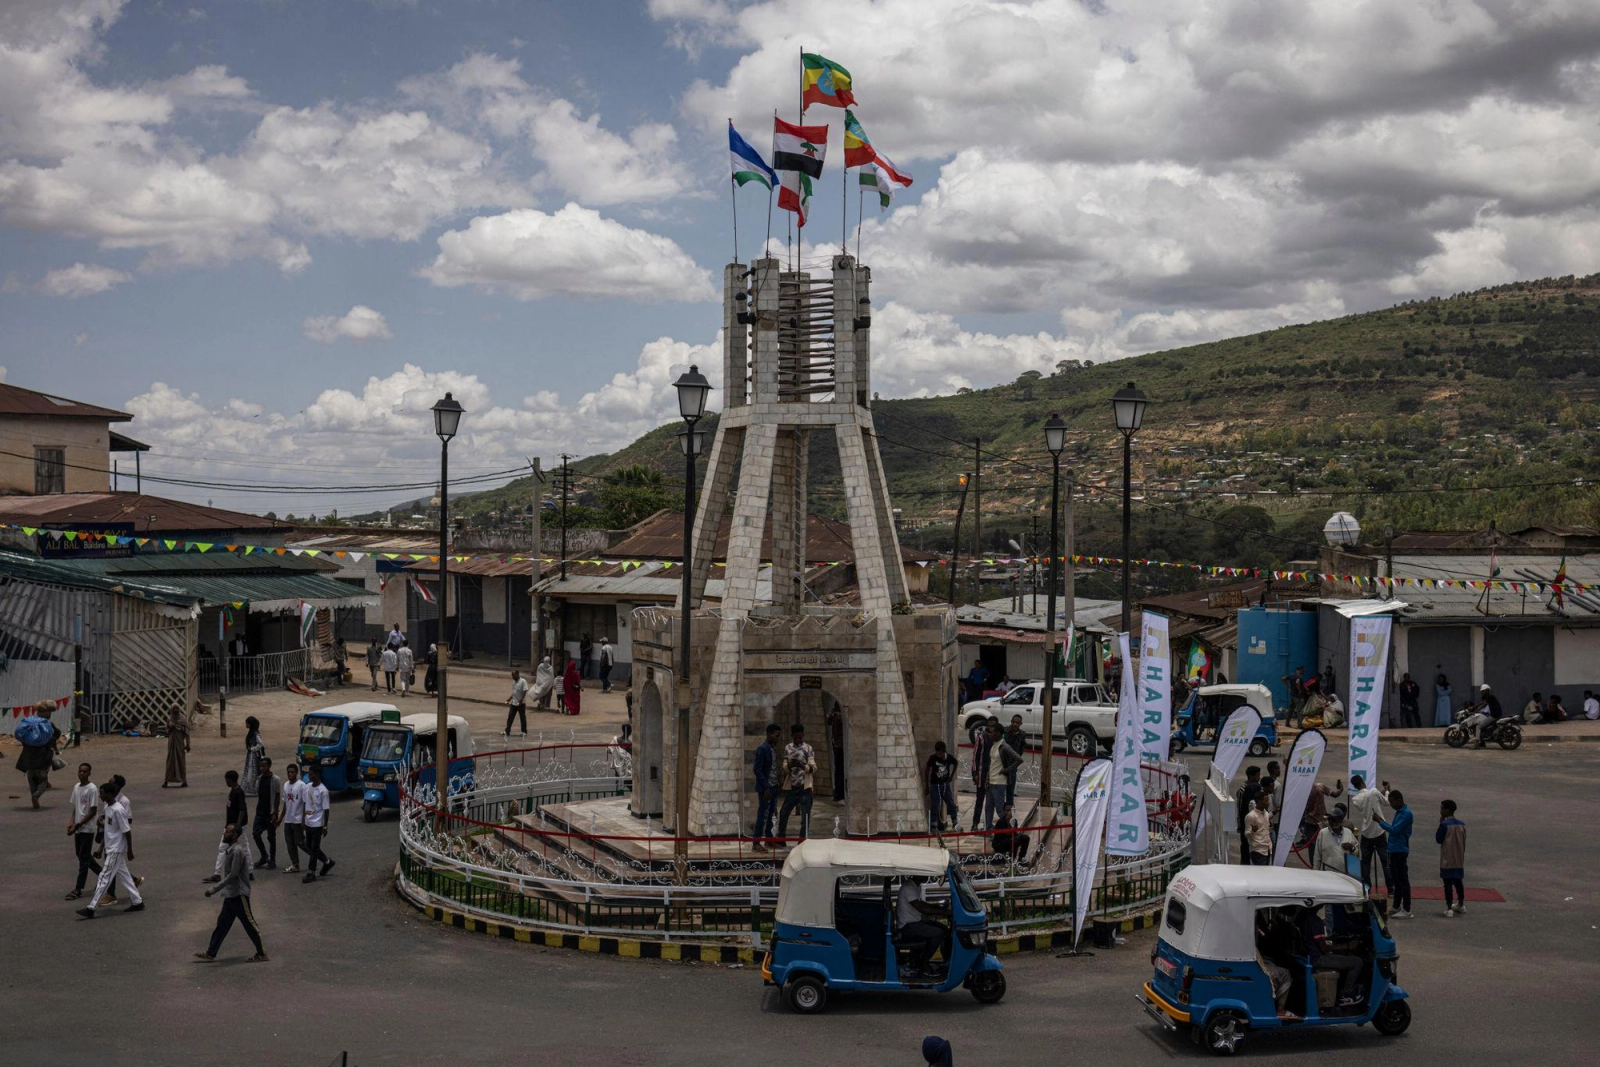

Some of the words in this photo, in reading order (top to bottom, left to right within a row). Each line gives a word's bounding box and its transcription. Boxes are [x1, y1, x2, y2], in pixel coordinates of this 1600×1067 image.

[46, 540, 61, 550] ALI
[63, 540, 79, 550] BAL
[1224, 737, 1249, 745] HARAR
[1118, 718, 1139, 842] ARAR
